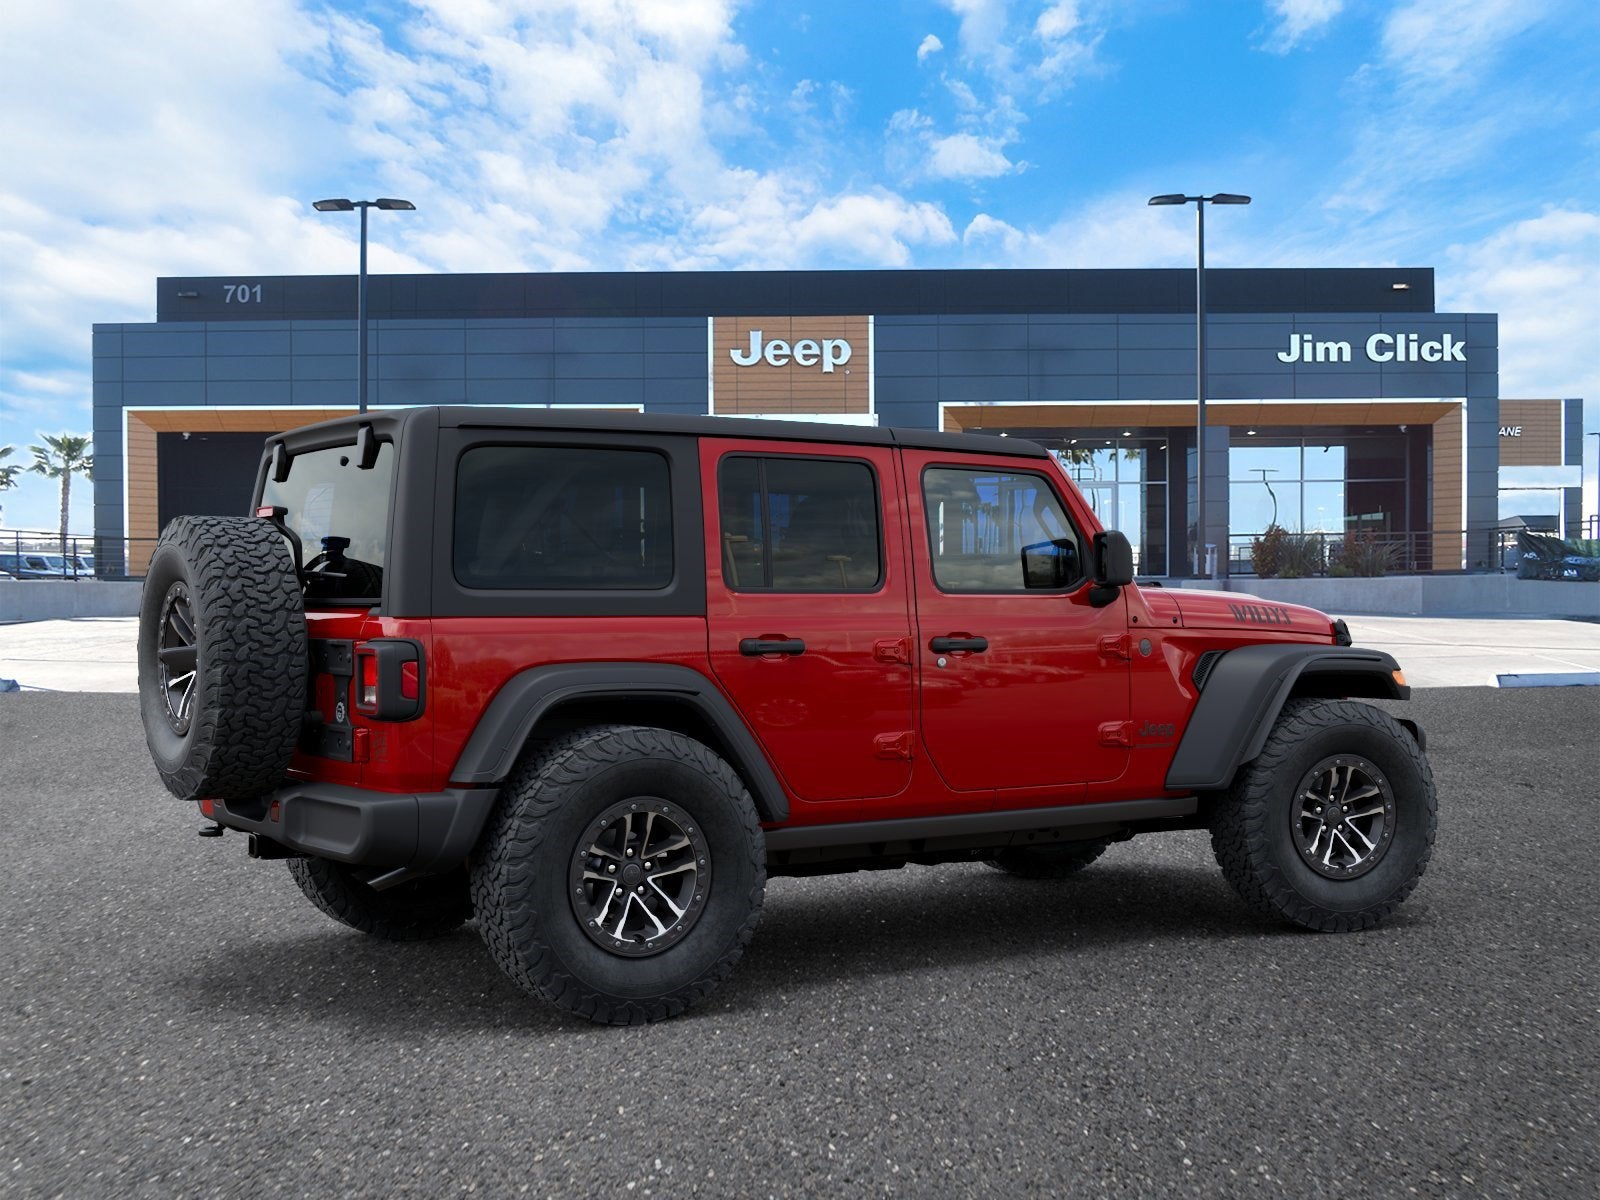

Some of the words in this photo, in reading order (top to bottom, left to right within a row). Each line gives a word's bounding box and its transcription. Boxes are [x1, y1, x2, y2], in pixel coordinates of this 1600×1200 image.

[223, 284, 262, 303] 701
[729, 330, 852, 374] Jeep
[1277, 333, 1352, 362] Jim
[1365, 333, 1467, 362] Click
[1139, 720, 1175, 740] Jeep
